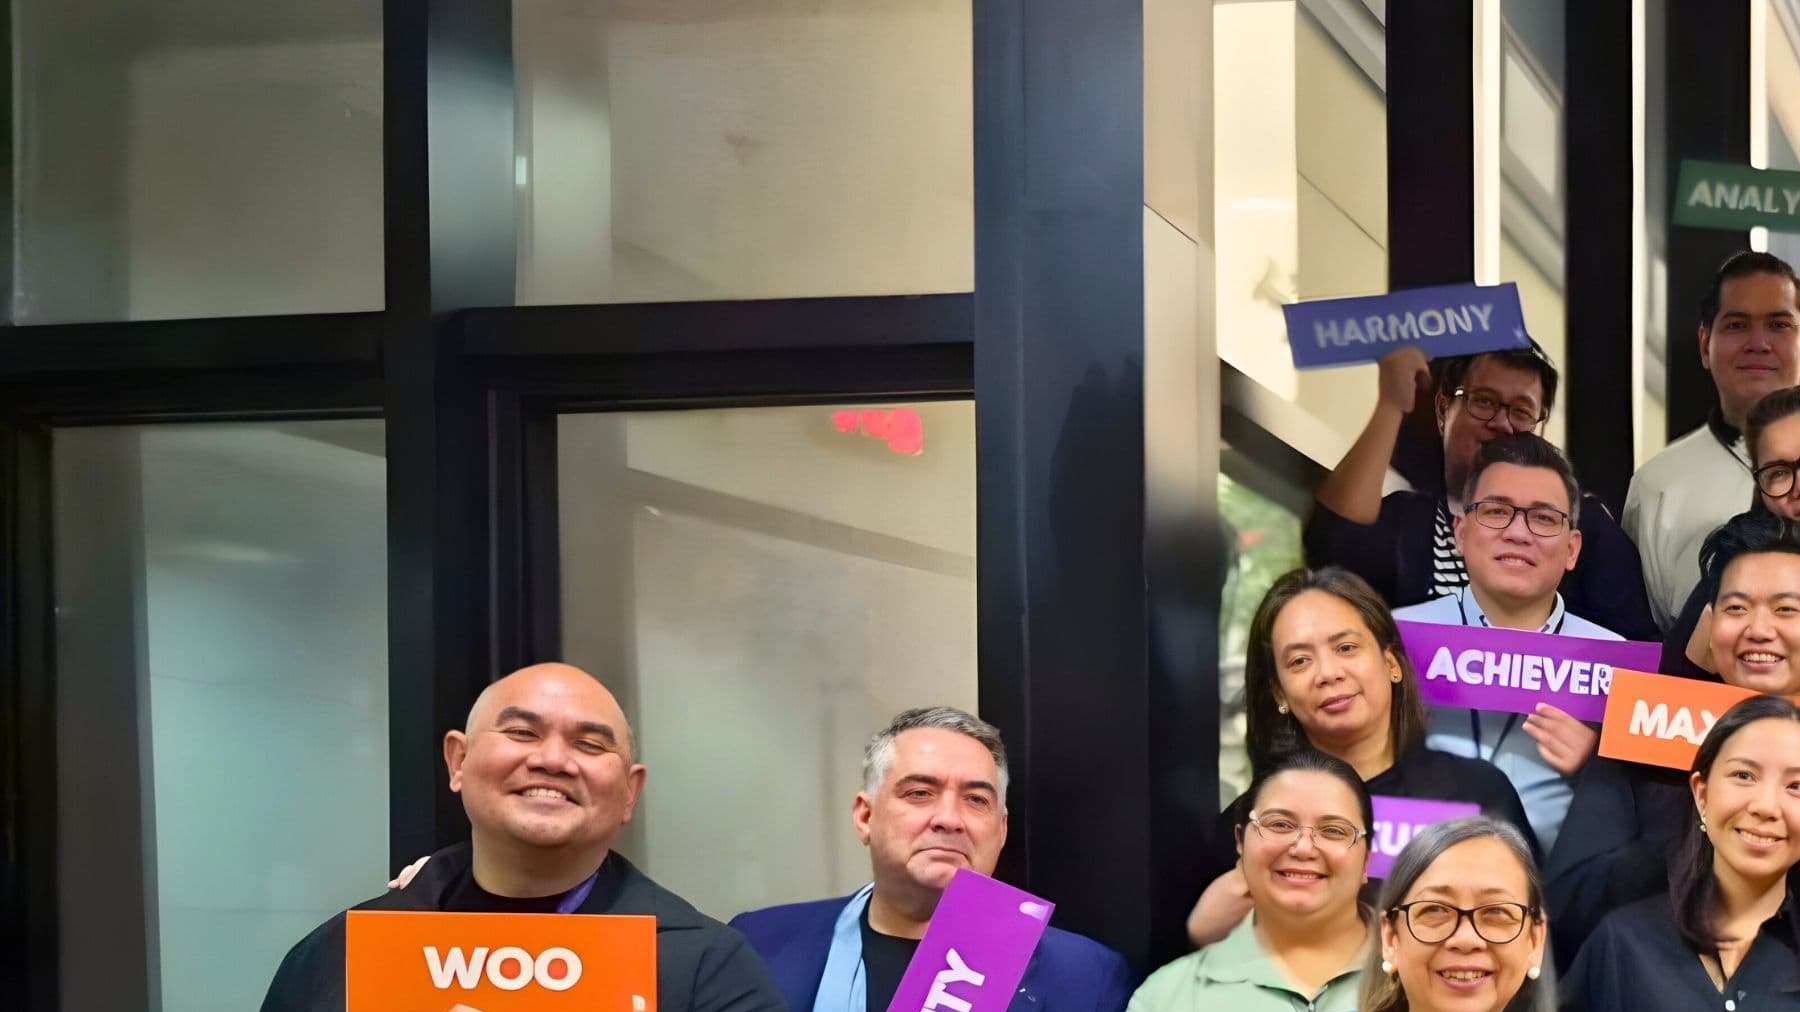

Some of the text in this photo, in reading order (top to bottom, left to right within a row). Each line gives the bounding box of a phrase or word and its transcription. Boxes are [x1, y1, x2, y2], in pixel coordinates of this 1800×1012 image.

[1312, 304, 1494, 348] HARMONY
[1425, 646, 1614, 695] ACHIEVER
[423, 946, 583, 991] WOO
